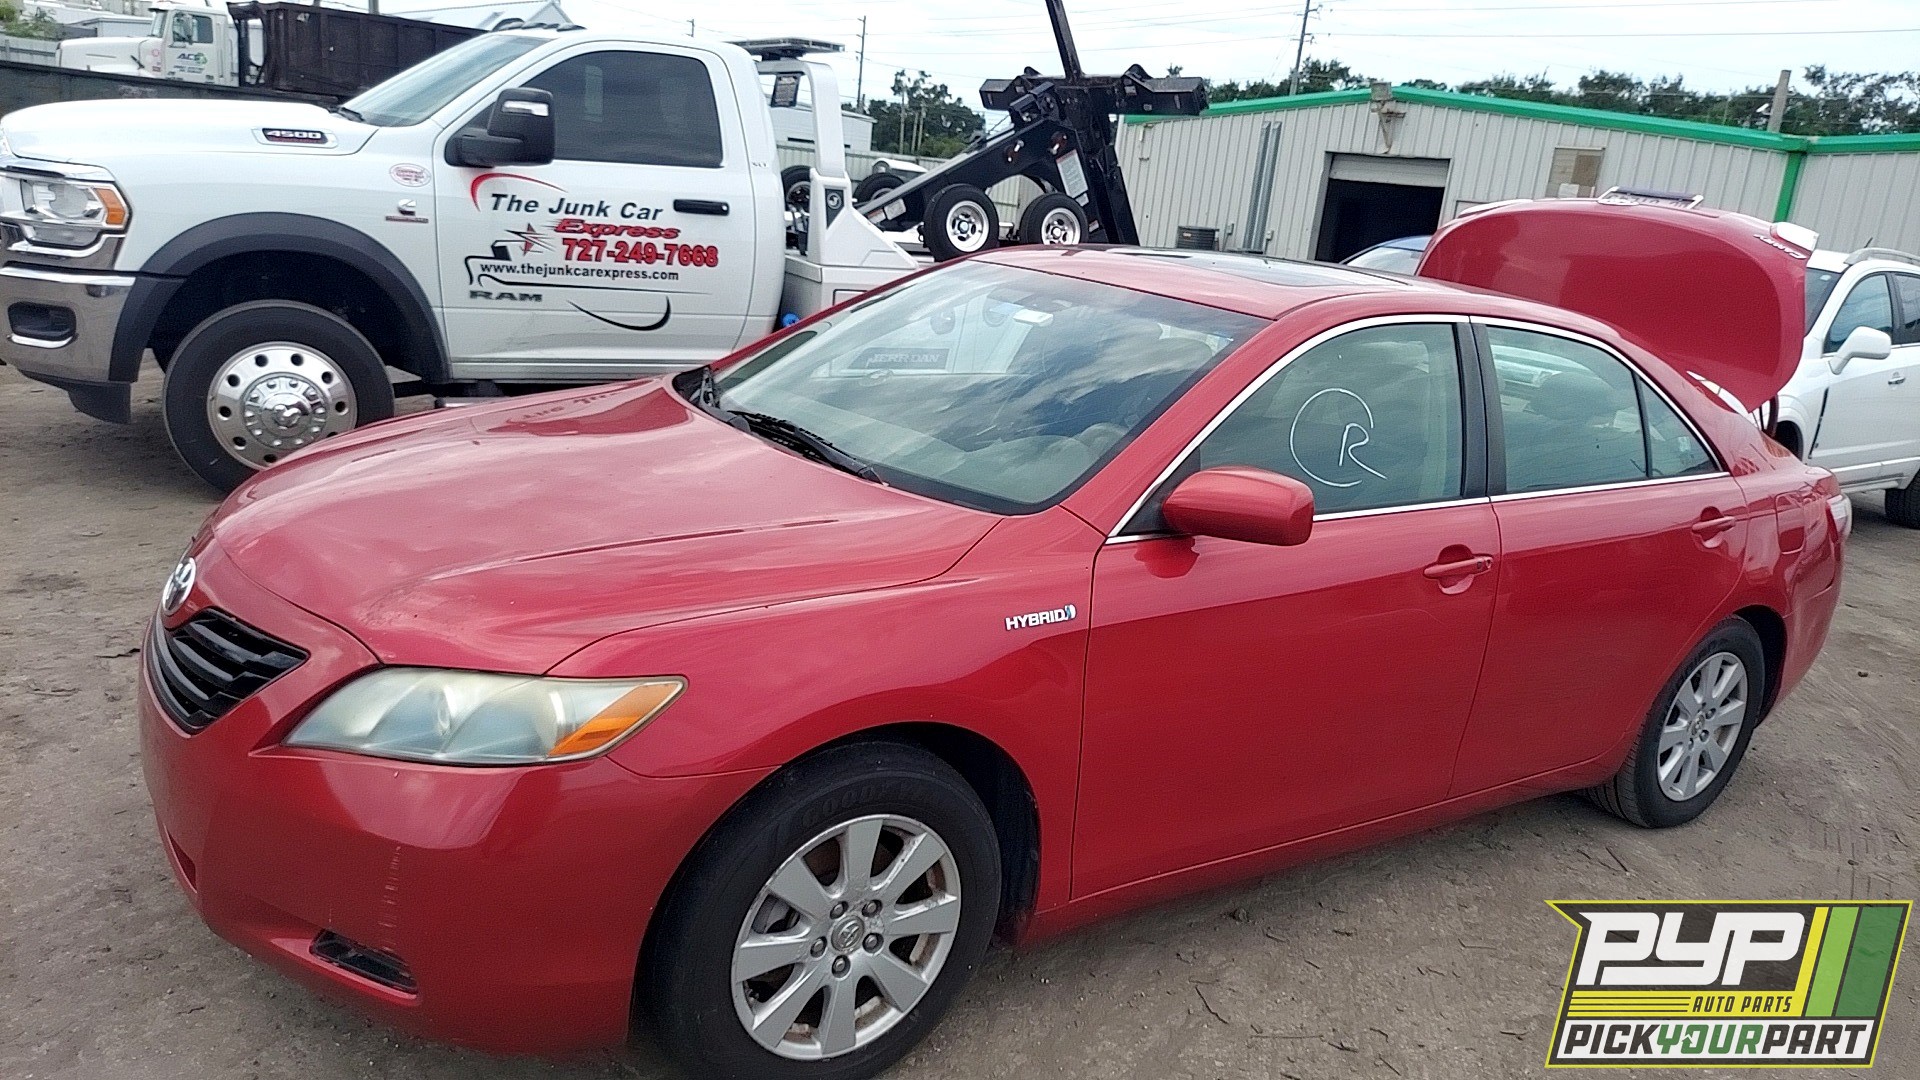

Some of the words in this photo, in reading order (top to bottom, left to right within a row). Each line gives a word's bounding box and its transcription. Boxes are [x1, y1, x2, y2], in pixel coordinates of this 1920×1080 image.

[266, 130, 322, 139] 4500
[491, 193, 539, 213] The
[548, 198, 610, 217] Junk
[620, 202, 663, 220] Car
[553, 218, 681, 239] Express
[562, 238, 719, 268] 727-249-7668
[480, 263, 679, 281] www.thejunkcarexpress.com
[469, 290, 543, 302] RAM
[1005, 608, 1068, 630] HYBRID
